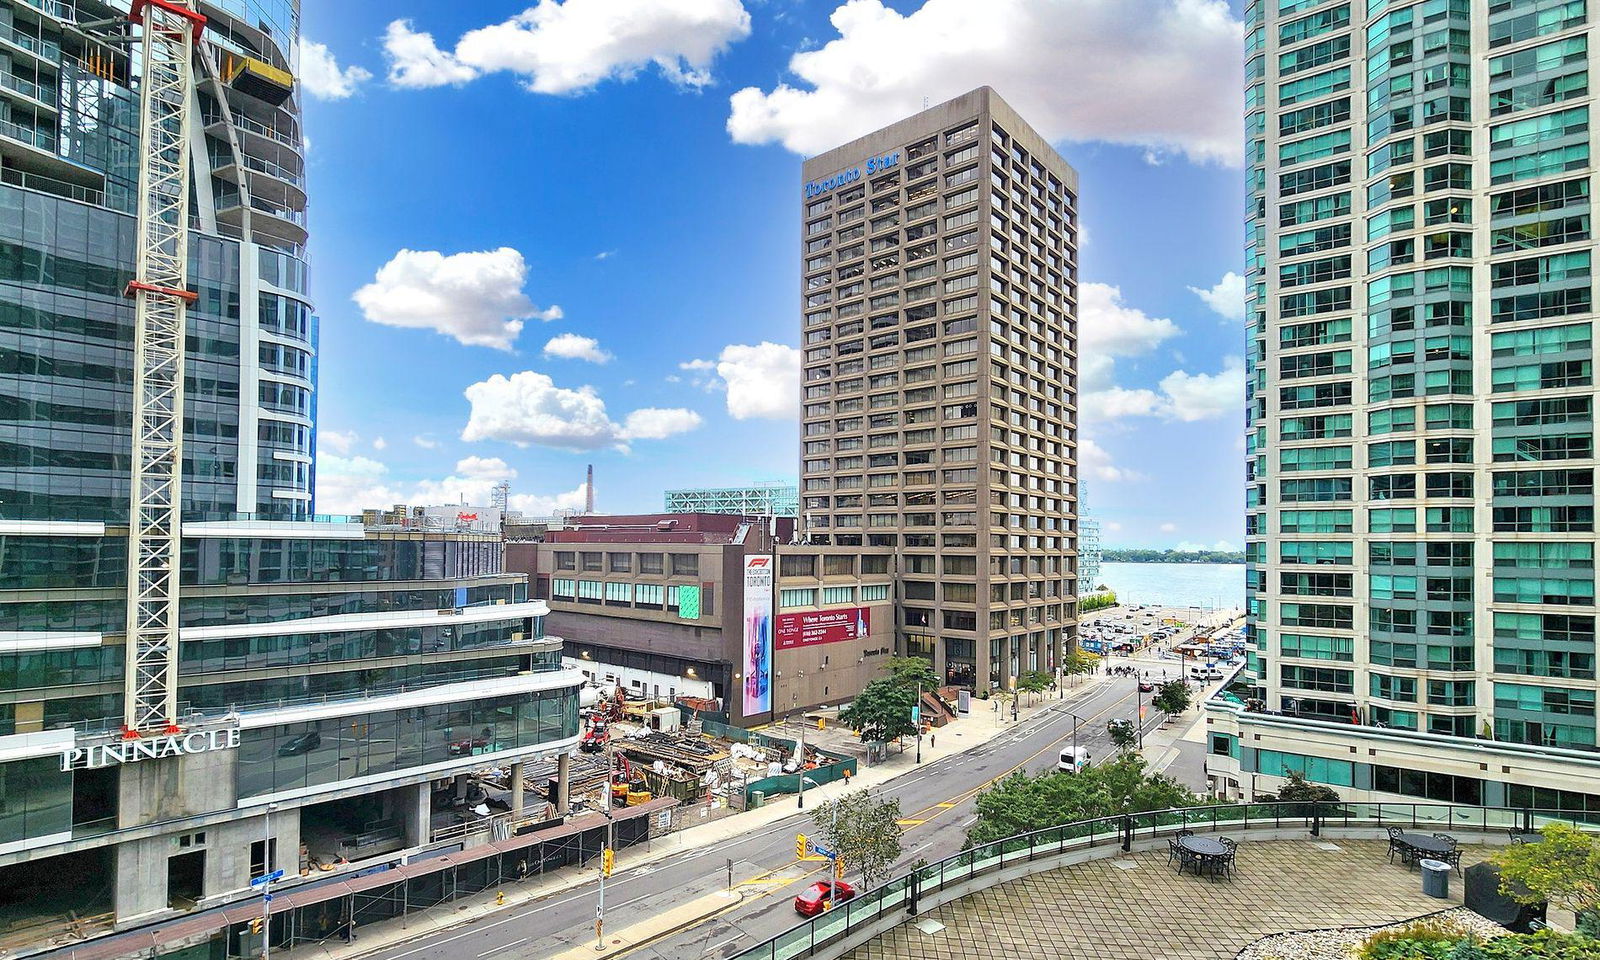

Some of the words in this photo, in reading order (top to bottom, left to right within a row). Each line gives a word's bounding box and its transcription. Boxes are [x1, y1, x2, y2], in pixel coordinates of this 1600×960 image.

[805, 166, 861, 199] Toronto
[865, 151, 900, 175] Star
[746, 575, 771, 587] TORONTO
[802, 616, 819, 624] Where
[819, 614, 836, 622] Toronto
[835, 613, 848, 621] Starts
[60, 727, 241, 772] PINNACLE
